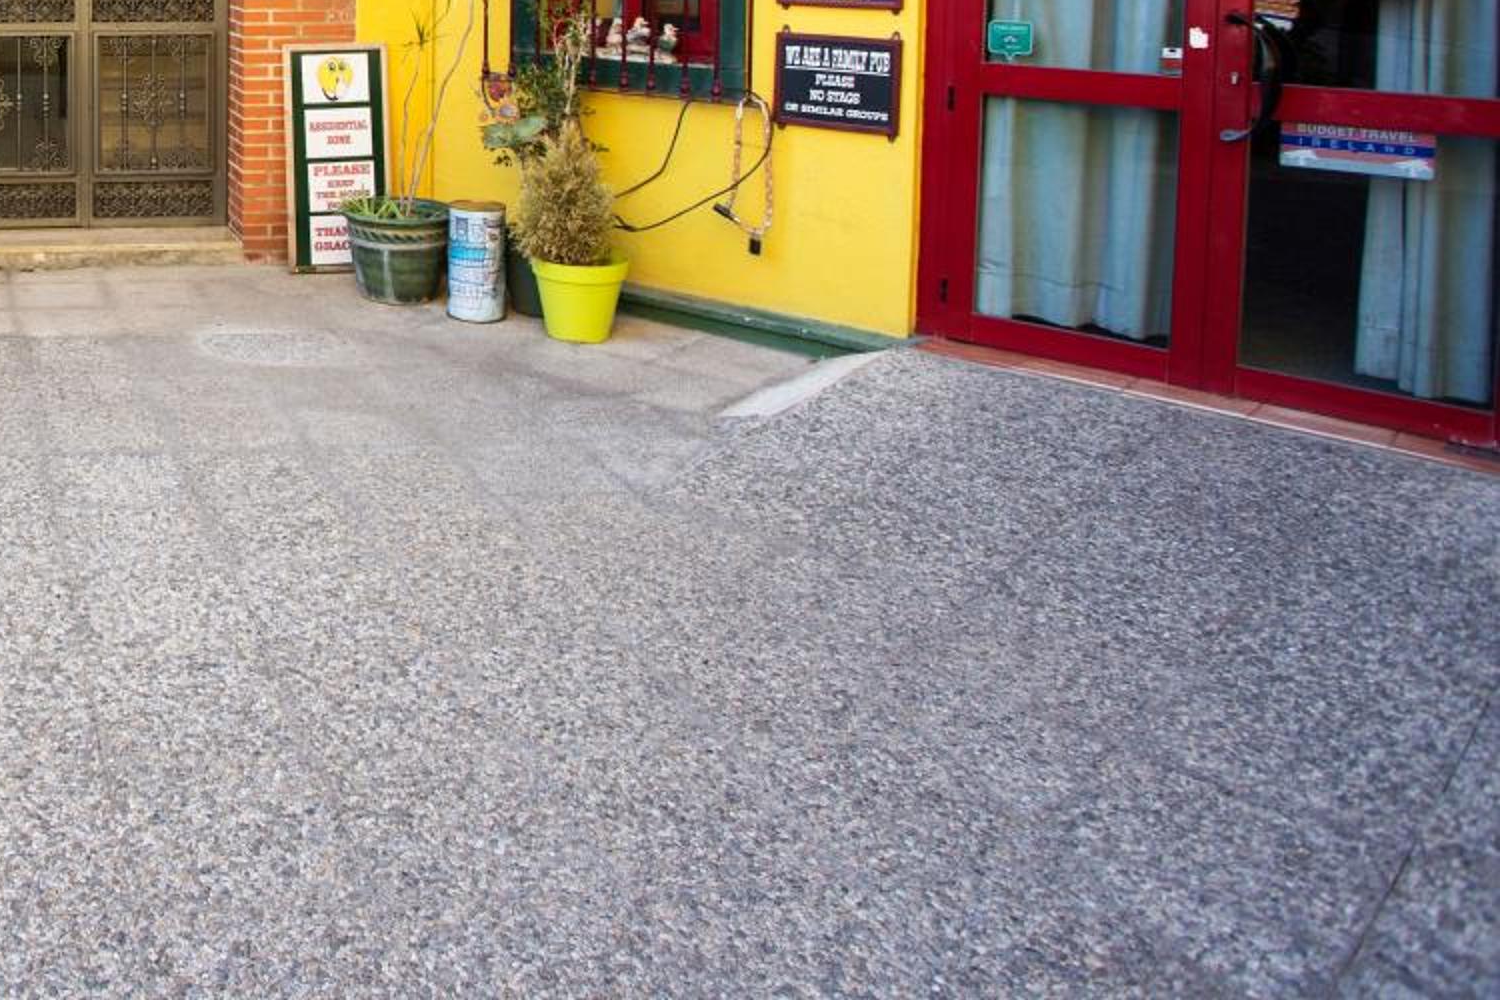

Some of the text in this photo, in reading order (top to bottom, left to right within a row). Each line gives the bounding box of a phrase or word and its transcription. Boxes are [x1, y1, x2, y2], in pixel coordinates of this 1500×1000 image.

[785, 45, 891, 73] WE ARE A FAMILY PUB
[815, 73, 855, 89] PLEASE
[809, 88, 861, 105] NO STAGS
[784, 102, 889, 122] OR SIMILAR GROUPS
[1296, 122, 1415, 143] BUDGET TRAVEL
[1298, 136, 1416, 156] IRELAND
[313, 163, 371, 177] PLEASE
[316, 190, 336, 199] THE
